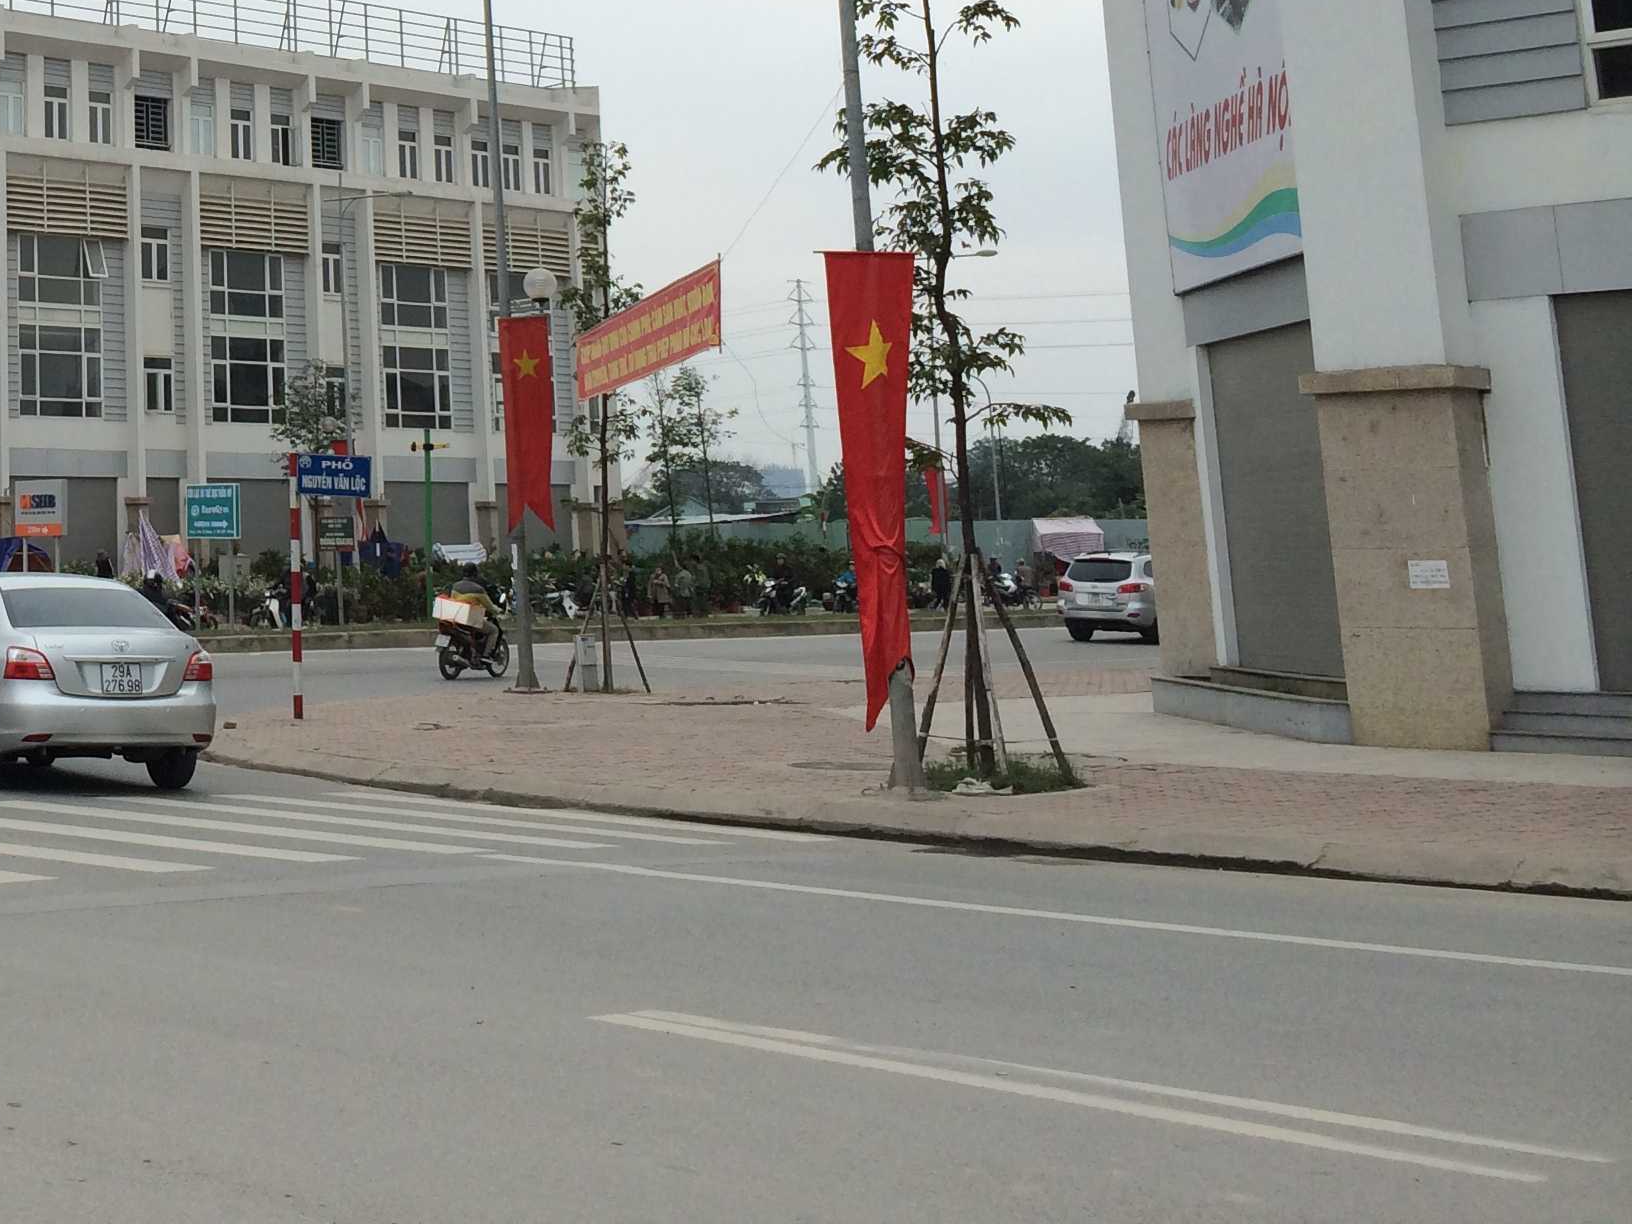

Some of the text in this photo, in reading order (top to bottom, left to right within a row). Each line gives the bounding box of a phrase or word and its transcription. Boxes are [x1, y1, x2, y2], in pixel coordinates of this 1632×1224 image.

[1167, 110, 1183, 181] CÁC
[1185, 102, 1211, 172] LÀNG
[1248, 66, 1263, 144] HÀ
[1267, 59, 1292, 151] NỘ
[320, 458, 353, 470] PHỐ
[334, 473, 349, 490] VĂN
[111, 664, 132, 677] 29A
